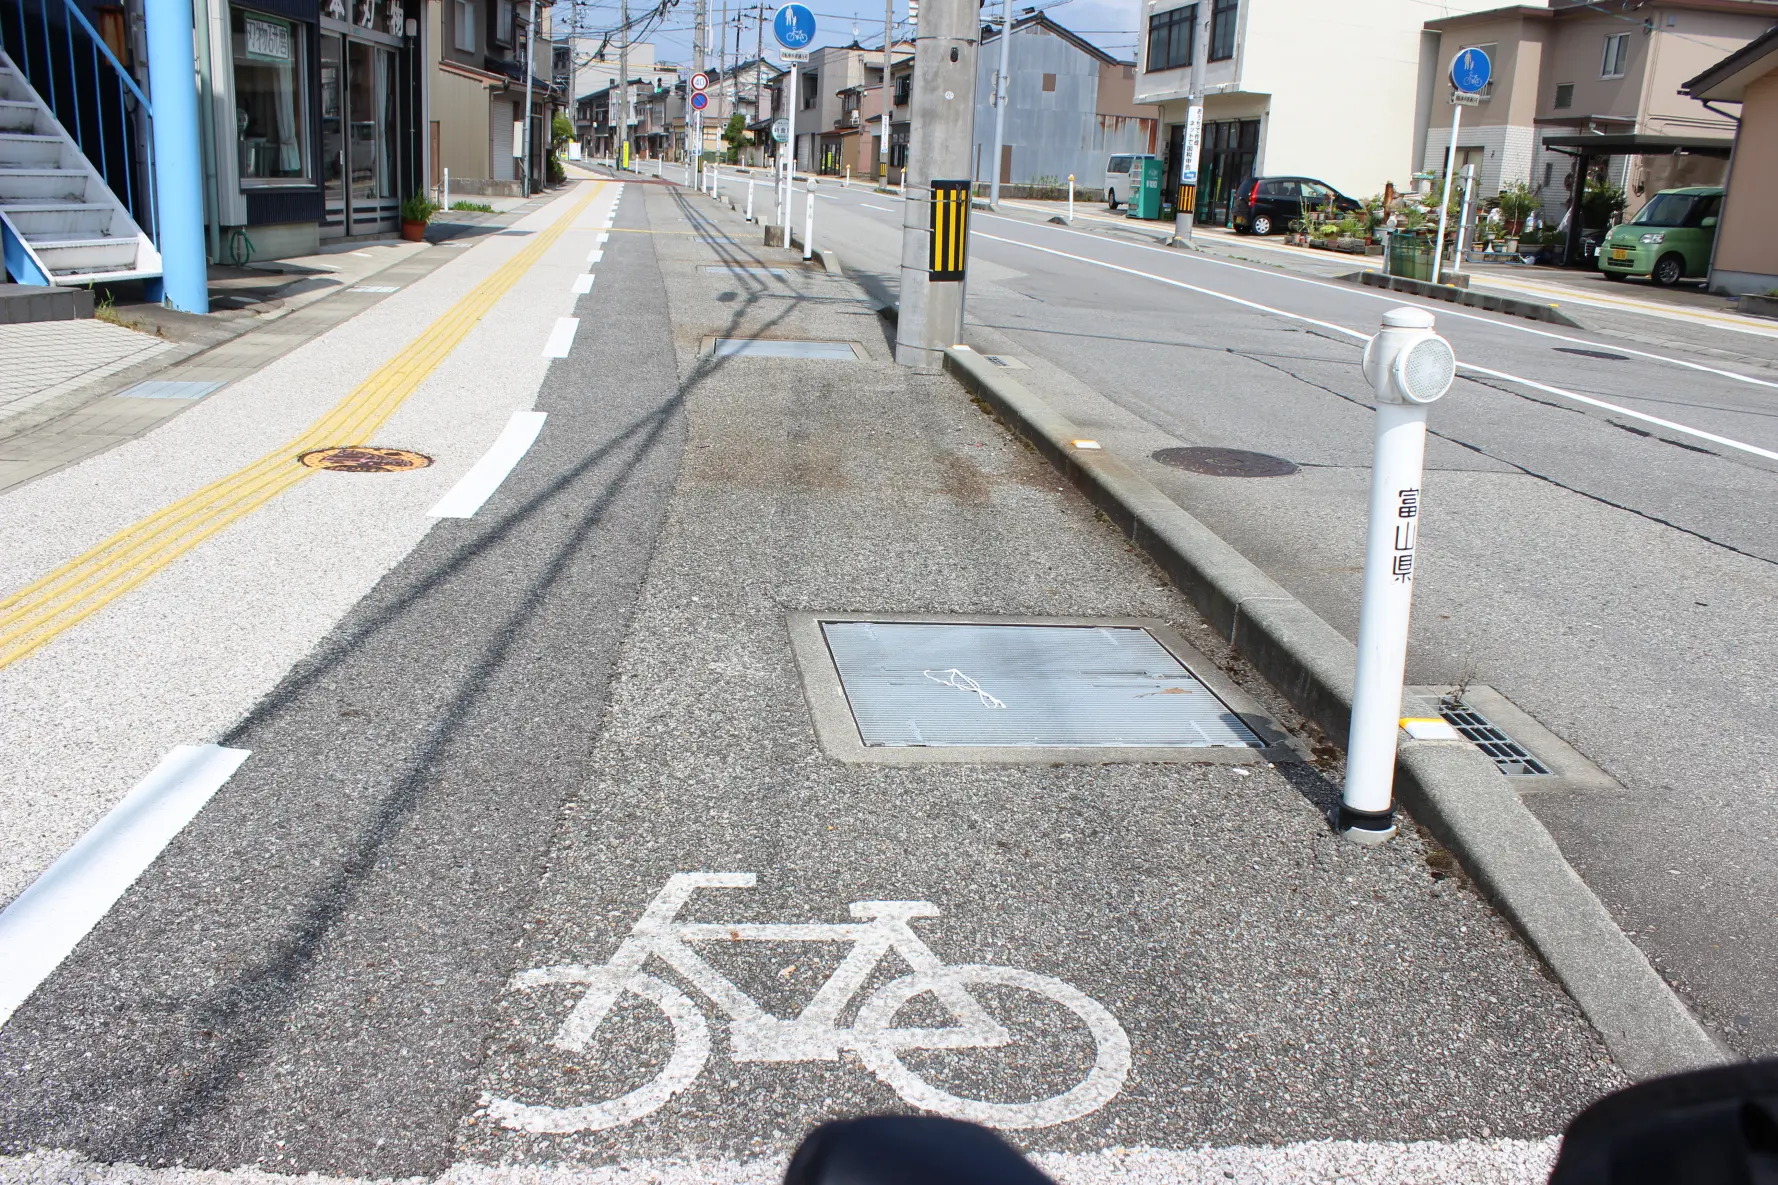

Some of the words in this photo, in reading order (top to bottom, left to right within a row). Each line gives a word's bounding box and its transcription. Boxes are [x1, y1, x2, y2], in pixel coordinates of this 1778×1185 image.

[694, 77, 705, 87] 40
[1392, 487, 1419, 583] 富山県
